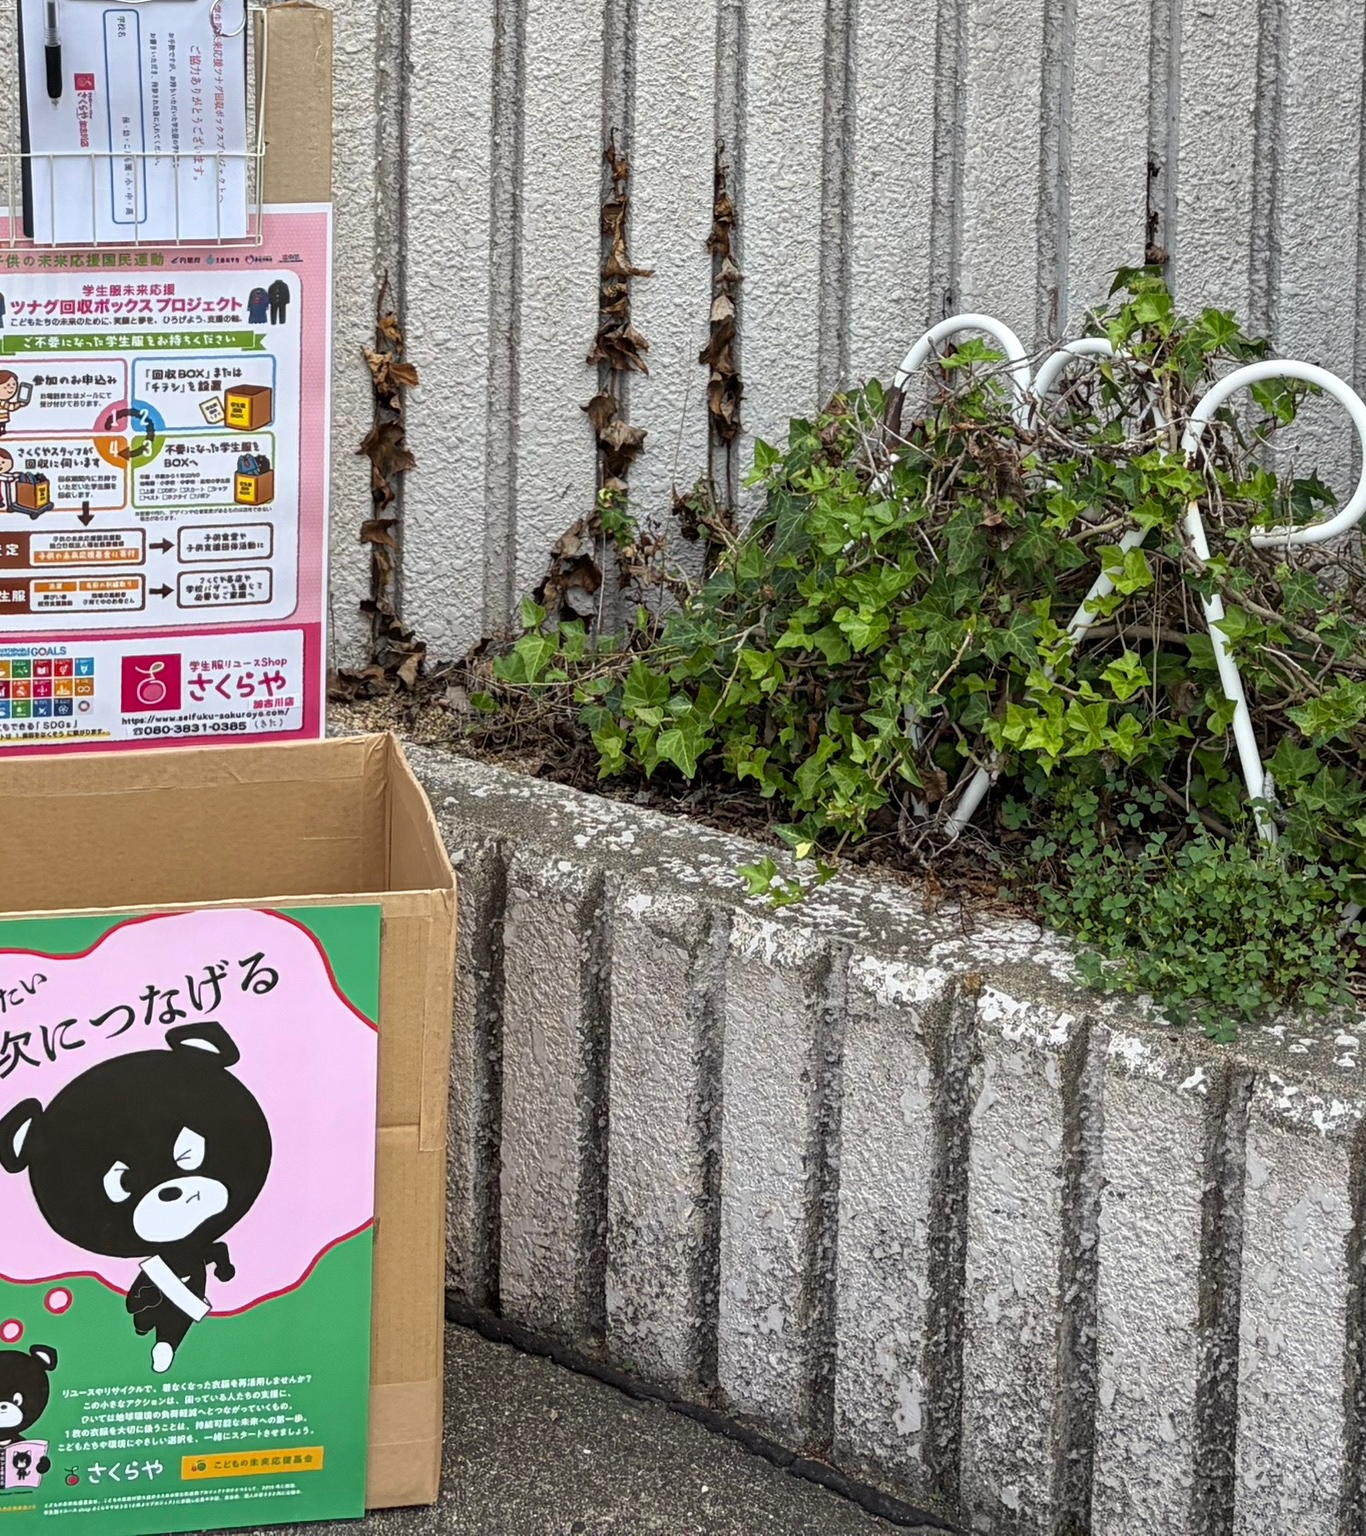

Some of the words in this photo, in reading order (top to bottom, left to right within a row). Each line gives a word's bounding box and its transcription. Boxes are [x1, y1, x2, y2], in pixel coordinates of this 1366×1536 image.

[117, 15, 126, 38] 学校名
[82, 283, 176, 297] 学生服未来応援
[23, 335, 237, 349] ご不要になった学生服をお持ちください
[32, 373, 118, 386] 参加のお申込み
[139, 408, 149, 425] 2
[17, 446, 94, 458] さくらやスタッフが
[109, 440, 118, 457] 4
[142, 439, 152, 457] 3
[165, 441, 260, 455] 不要になった学生服を
[25, 457, 100, 470] 回収に伺います
[164, 458, 198, 468] BOXへ
[31, 646, 67, 657] GOALS
[188, 657, 288, 672] 学生服リユースShop
[187, 670, 287, 702] さくらや
[252, 696, 295, 710] 加古川店
[144, 721, 247, 736] 080-3831-0385
[213, 1454, 314, 1470] こどもの未来応援基金
[87, 1459, 163, 1484] さくらや
